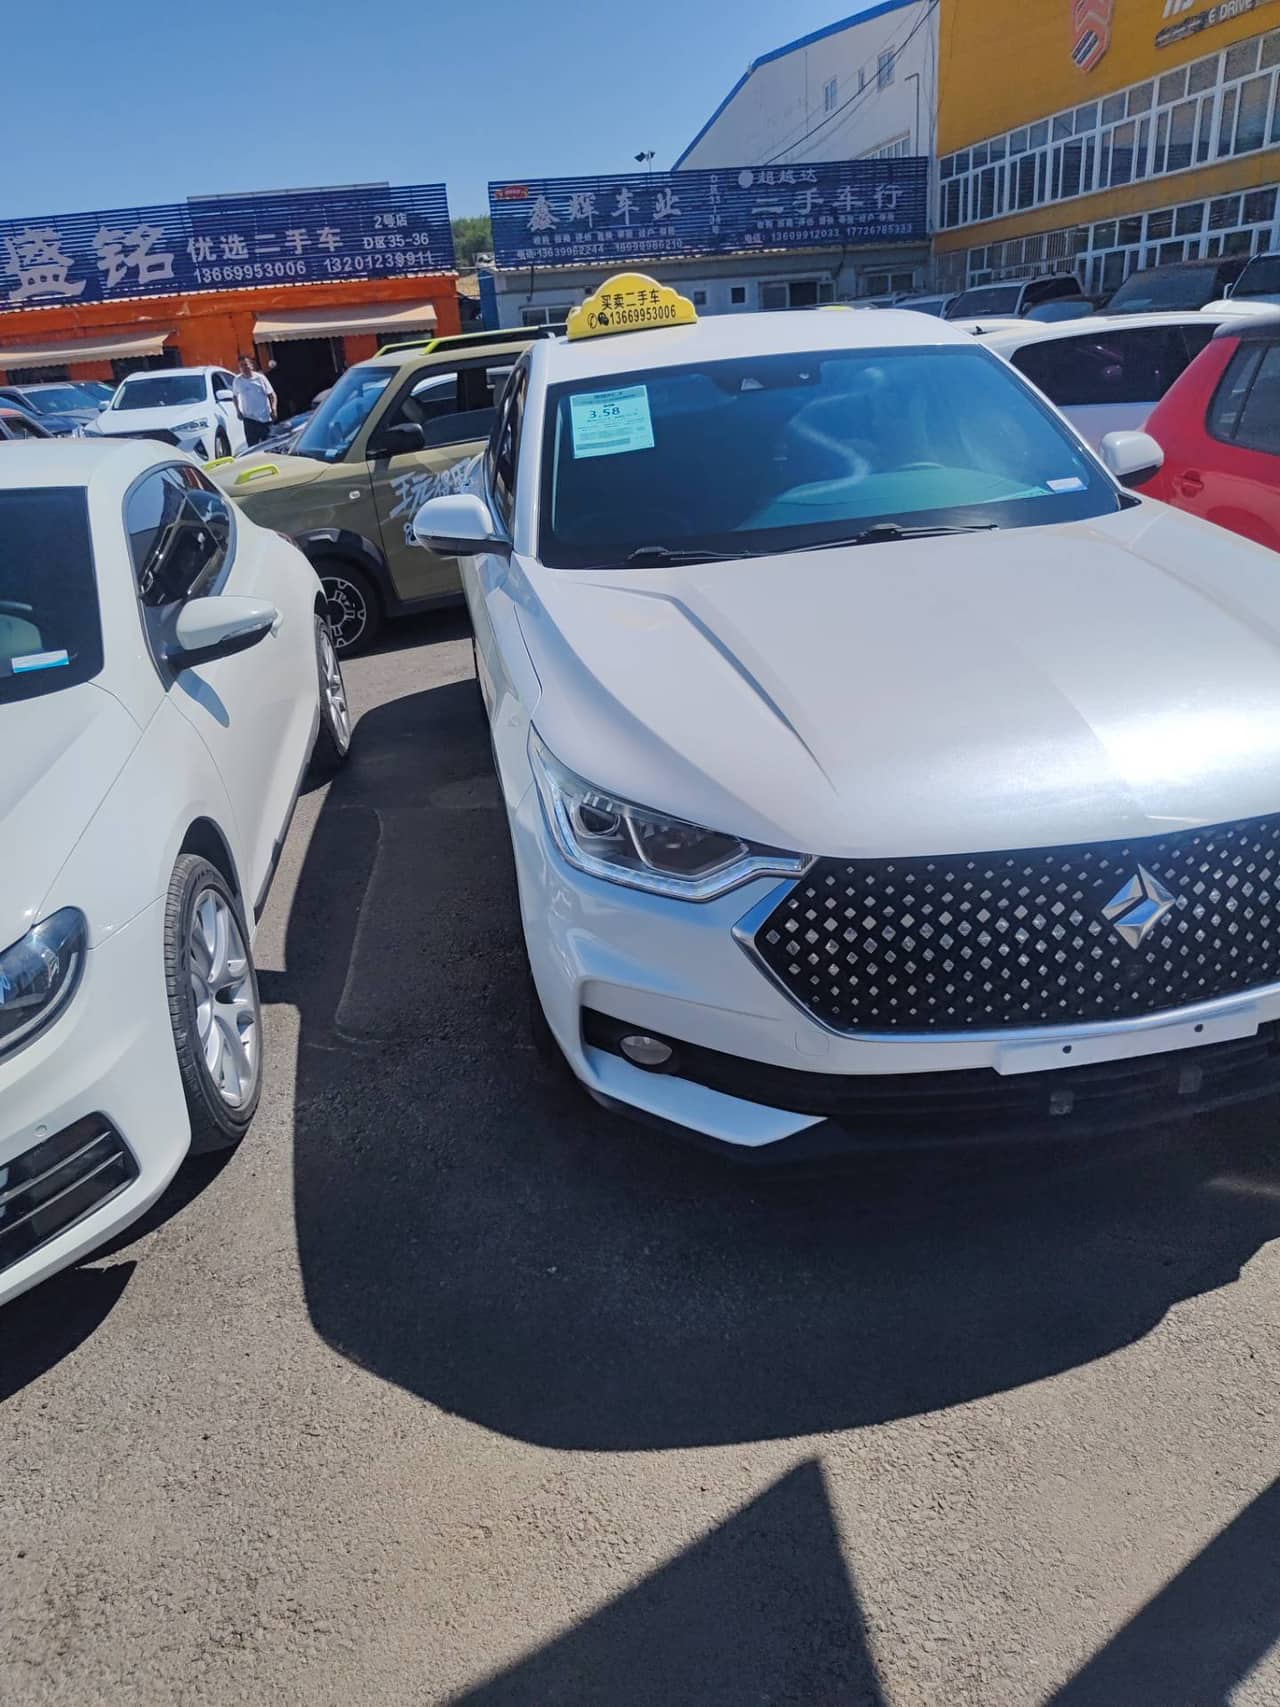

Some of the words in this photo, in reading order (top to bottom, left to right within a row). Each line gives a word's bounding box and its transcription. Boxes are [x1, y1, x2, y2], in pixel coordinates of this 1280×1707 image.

[526, 187, 683, 232] 鑫辉车业
[751, 183, 903, 216] 二手车行
[373, 213, 409, 229] 2号店
[187, 226, 344, 263] 优选二手车
[362, 232, 430, 250] D区35-36
[4, 224, 175, 300] 盛铭
[193, 260, 307, 284] 13669953006
[322, 250, 434, 274] 13201239911
[600, 289, 662, 311] 买卖二手车
[609, 304, 677, 326] 13669953006
[589, 406, 621, 419] 3.58
